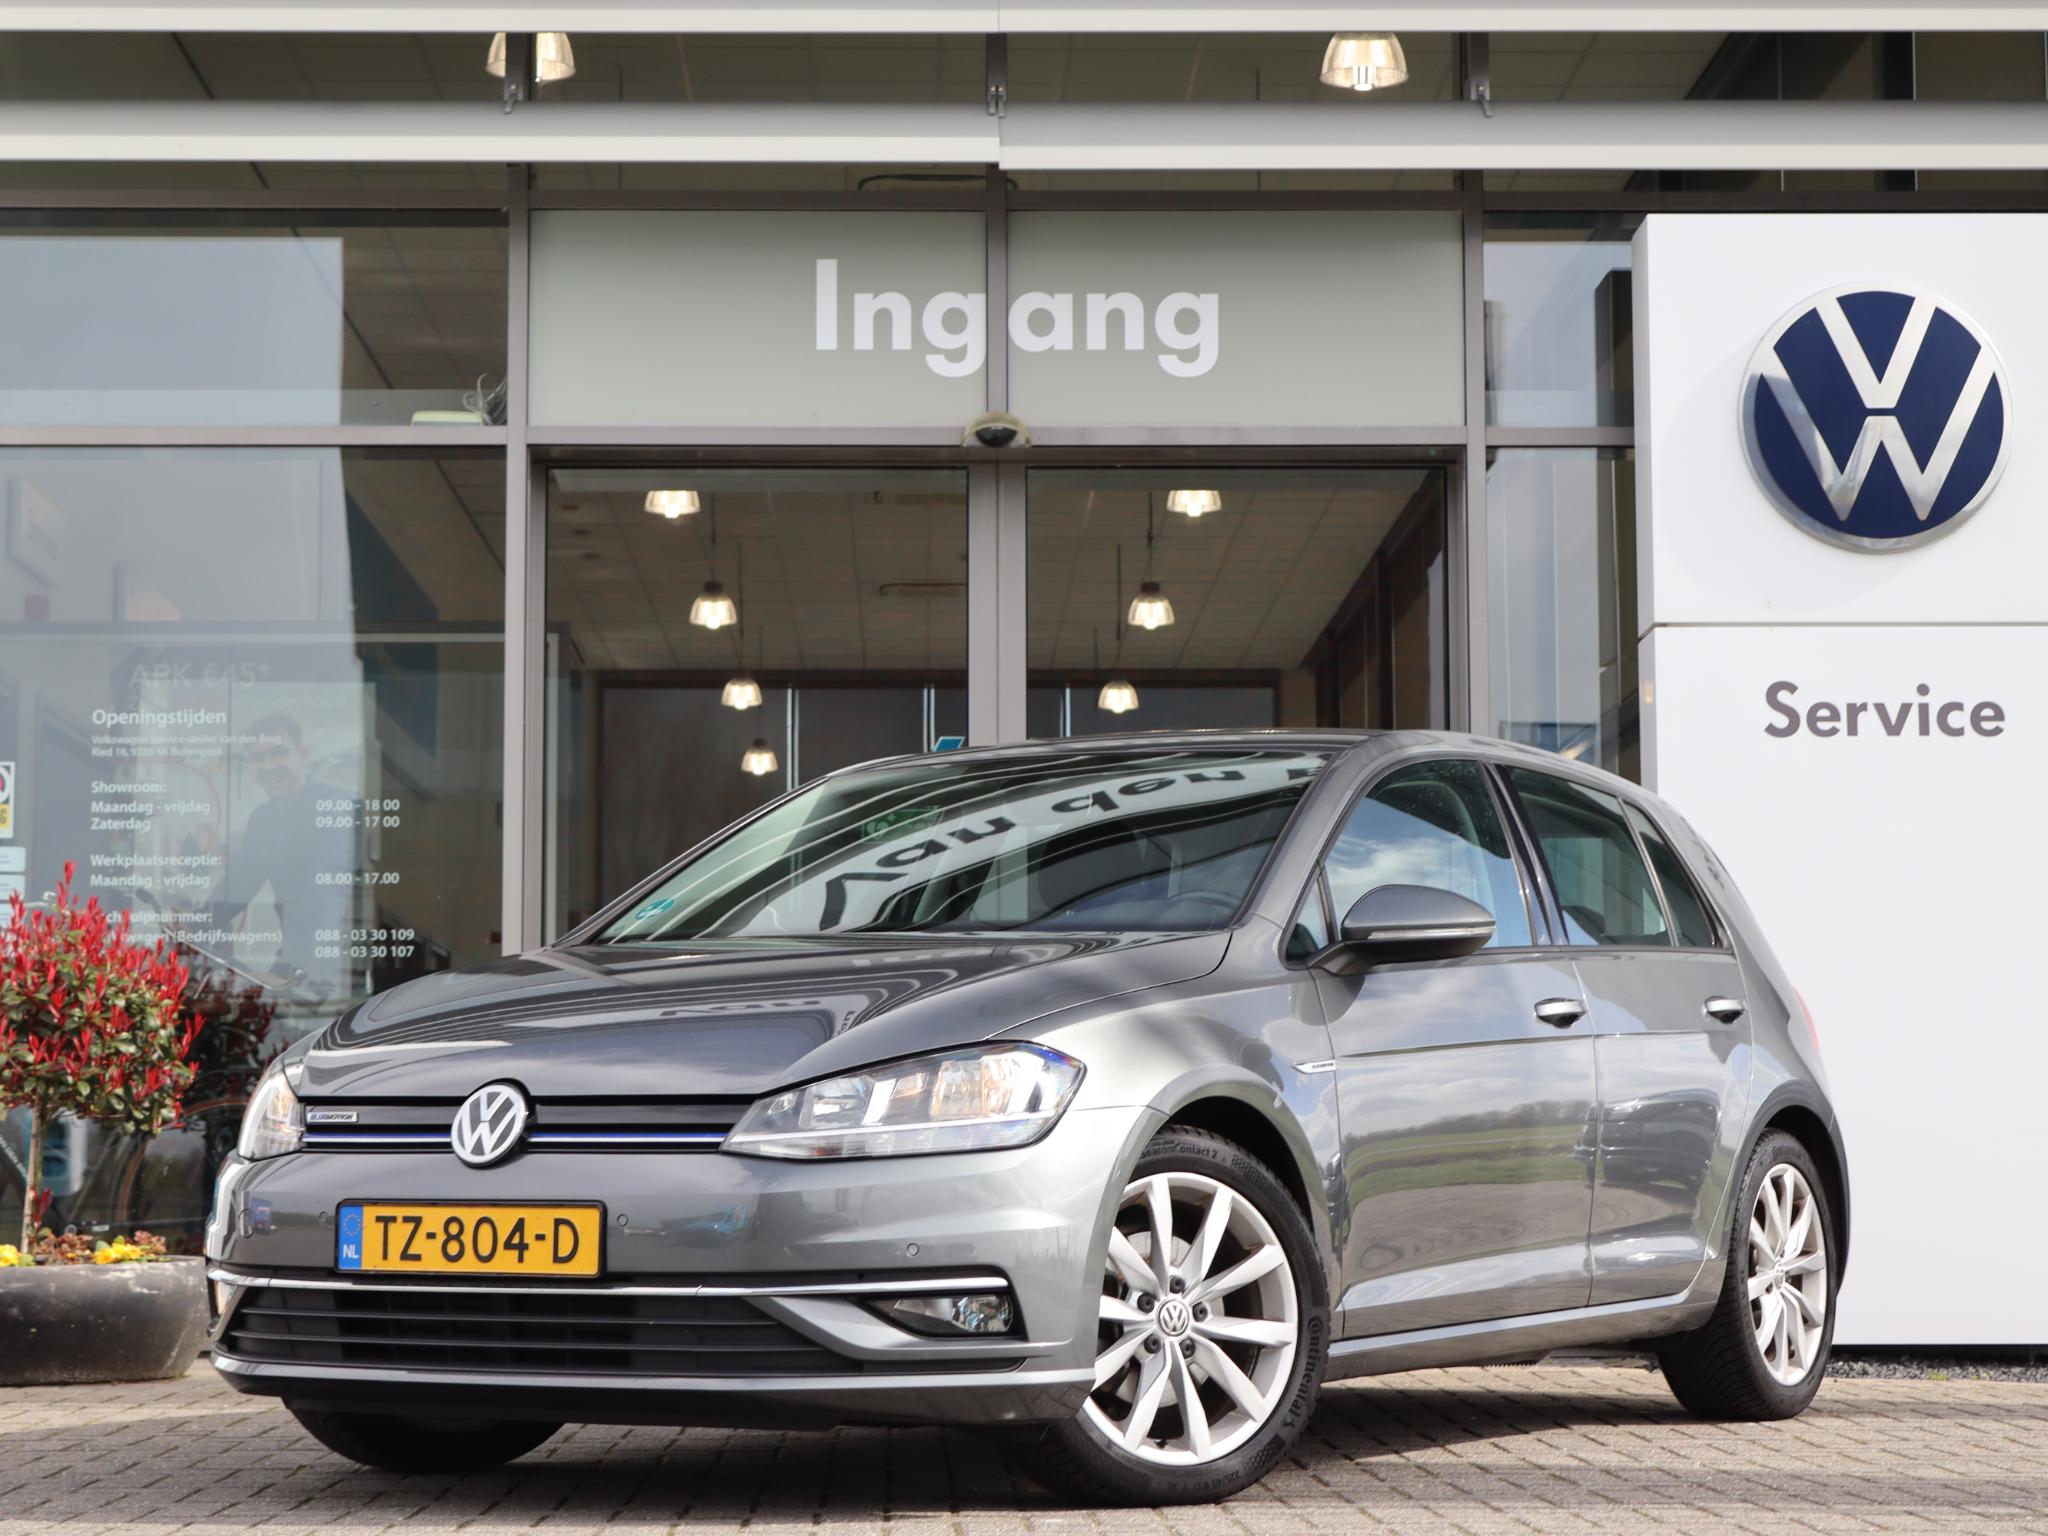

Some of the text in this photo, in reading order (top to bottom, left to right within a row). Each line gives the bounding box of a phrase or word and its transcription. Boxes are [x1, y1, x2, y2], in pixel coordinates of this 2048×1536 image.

[815, 258, 1219, 378] Ingang
[1764, 680, 2005, 738] Service
[92, 708, 227, 728] Openingstijden
[91, 781, 167, 794] Showroom:
[90, 801, 153, 815] Maandag
[164, 800, 211, 815] vrijdag
[316, 799, 352, 811] 09.00
[90, 818, 151, 832] Zaterdag
[316, 816, 352, 828] 09.00
[90, 854, 222, 869] Werkplaatsreceptie:
[90, 874, 153, 889] Maandag
[164, 874, 210, 889] vrijdag
[315, 872, 352, 884] 08.00
[364, 872, 400, 884] 17.00
[172, 929, 283, 945] (Bedrijfswagens)
[315, 930, 340, 941] 088
[351, 930, 368, 941] 03
[370, 930, 387, 941] 30
[391, 929, 415, 941] 109
[315, 946, 340, 958] 088
[351, 946, 368, 958] 03
[370, 946, 387, 958] 30
[391, 946, 415, 958] 107
[375, 1215, 580, 1264] TZ-804-D
[342, 1243, 360, 1260] NL
[1289, 1315, 1324, 1418] Continental
